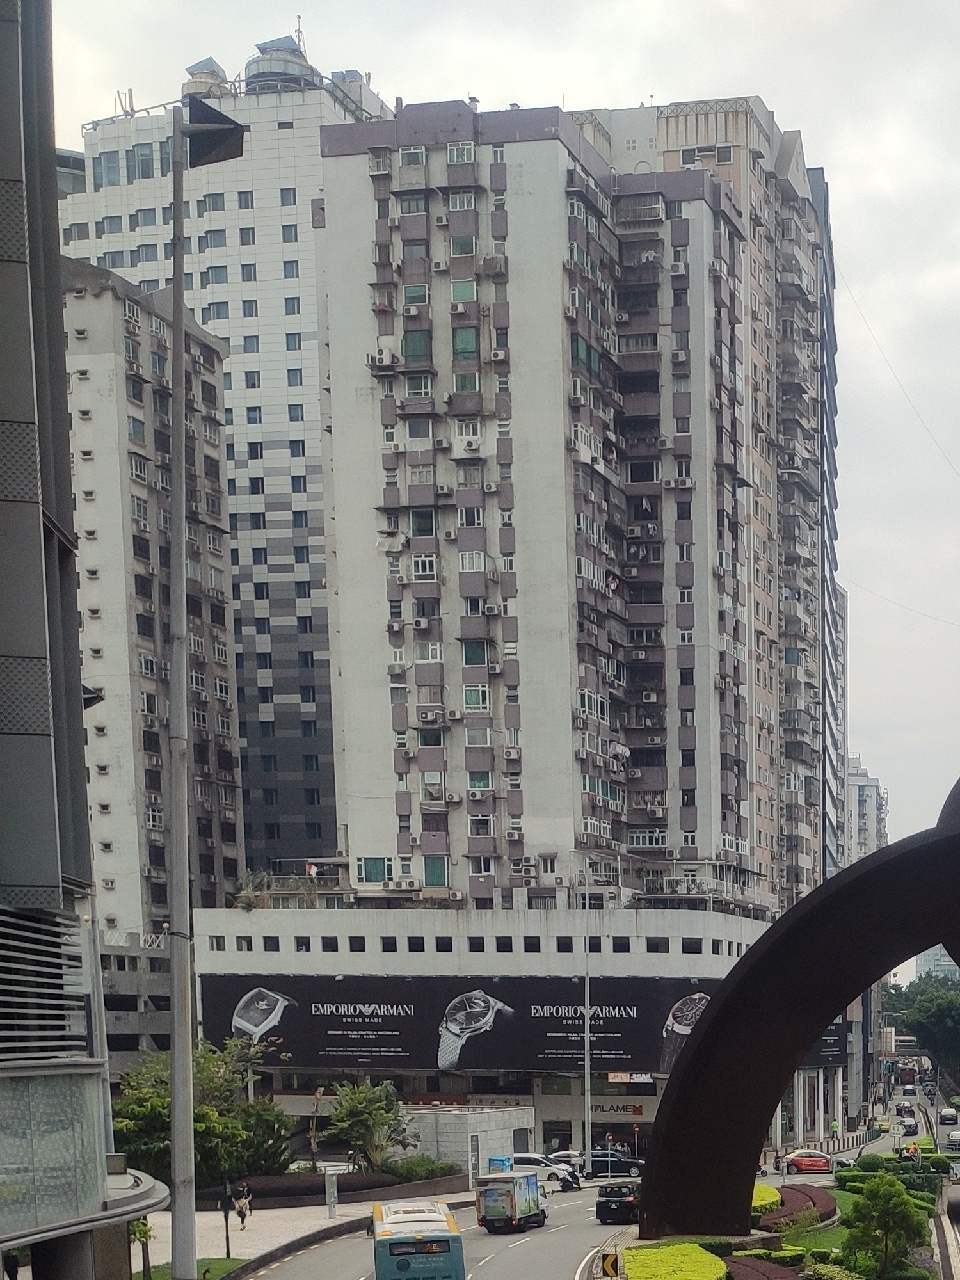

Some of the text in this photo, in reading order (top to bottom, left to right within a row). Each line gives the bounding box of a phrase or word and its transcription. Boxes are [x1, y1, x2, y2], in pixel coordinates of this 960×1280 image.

[311, 1003, 414, 1016] EMPORIO ARMANI
[531, 1005, 637, 1018] EMPORIO ARMANI
